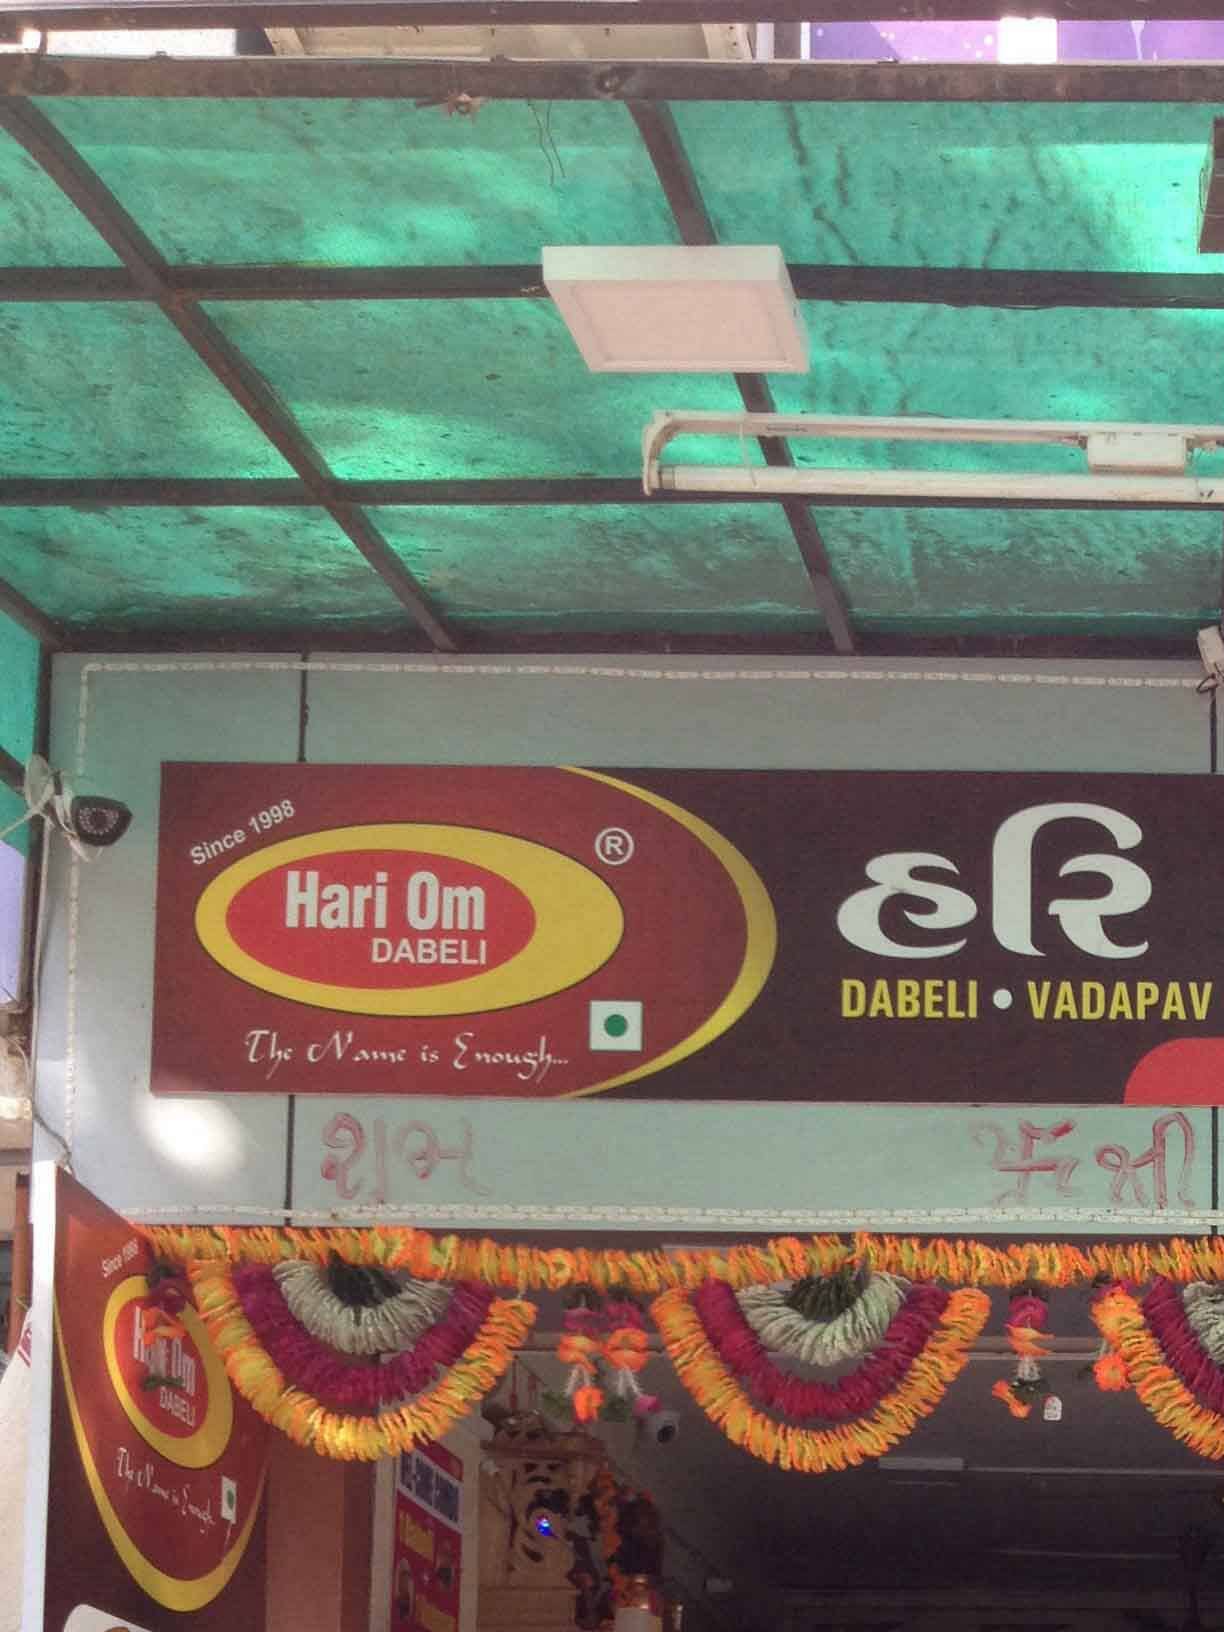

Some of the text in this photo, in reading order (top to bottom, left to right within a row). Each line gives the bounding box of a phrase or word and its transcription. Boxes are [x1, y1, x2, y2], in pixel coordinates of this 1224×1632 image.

[190, 800, 296, 866] Since 1998
[284, 870, 486, 931] Hari Om
[837, 802, 1153, 959] હરિ
[370, 937, 488, 966] DABELI
[840, 978, 980, 1019] DABELI
[1027, 980, 1214, 1021] VADAPAV
[244, 1029, 293, 1080] The
[307, 1030, 408, 1064] Name
[420, 1043, 441, 1063] is
